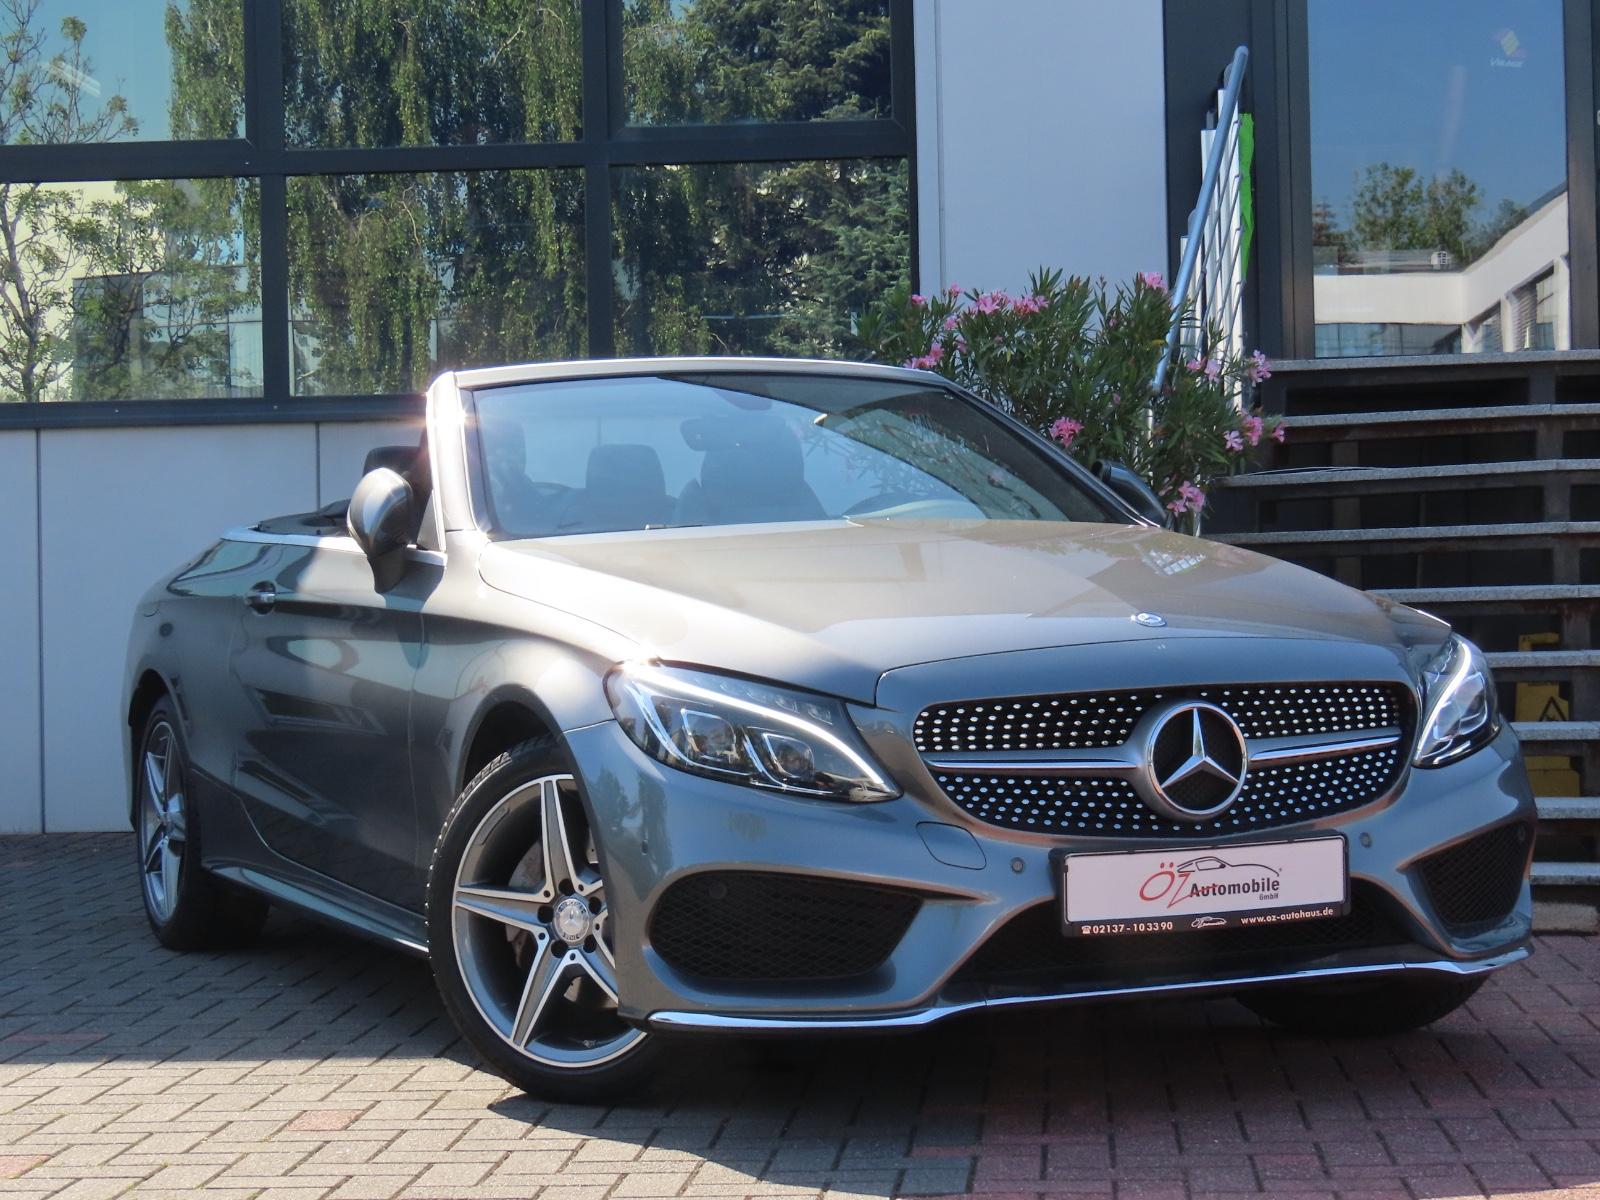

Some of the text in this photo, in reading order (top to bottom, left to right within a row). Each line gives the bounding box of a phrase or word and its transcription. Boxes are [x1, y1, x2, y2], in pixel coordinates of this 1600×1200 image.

[1190, 878, 1280, 898] Automobile
[1259, 893, 1279, 901] GmbH
[1241, 906, 1334, 924] www.oz-autohaus.de
